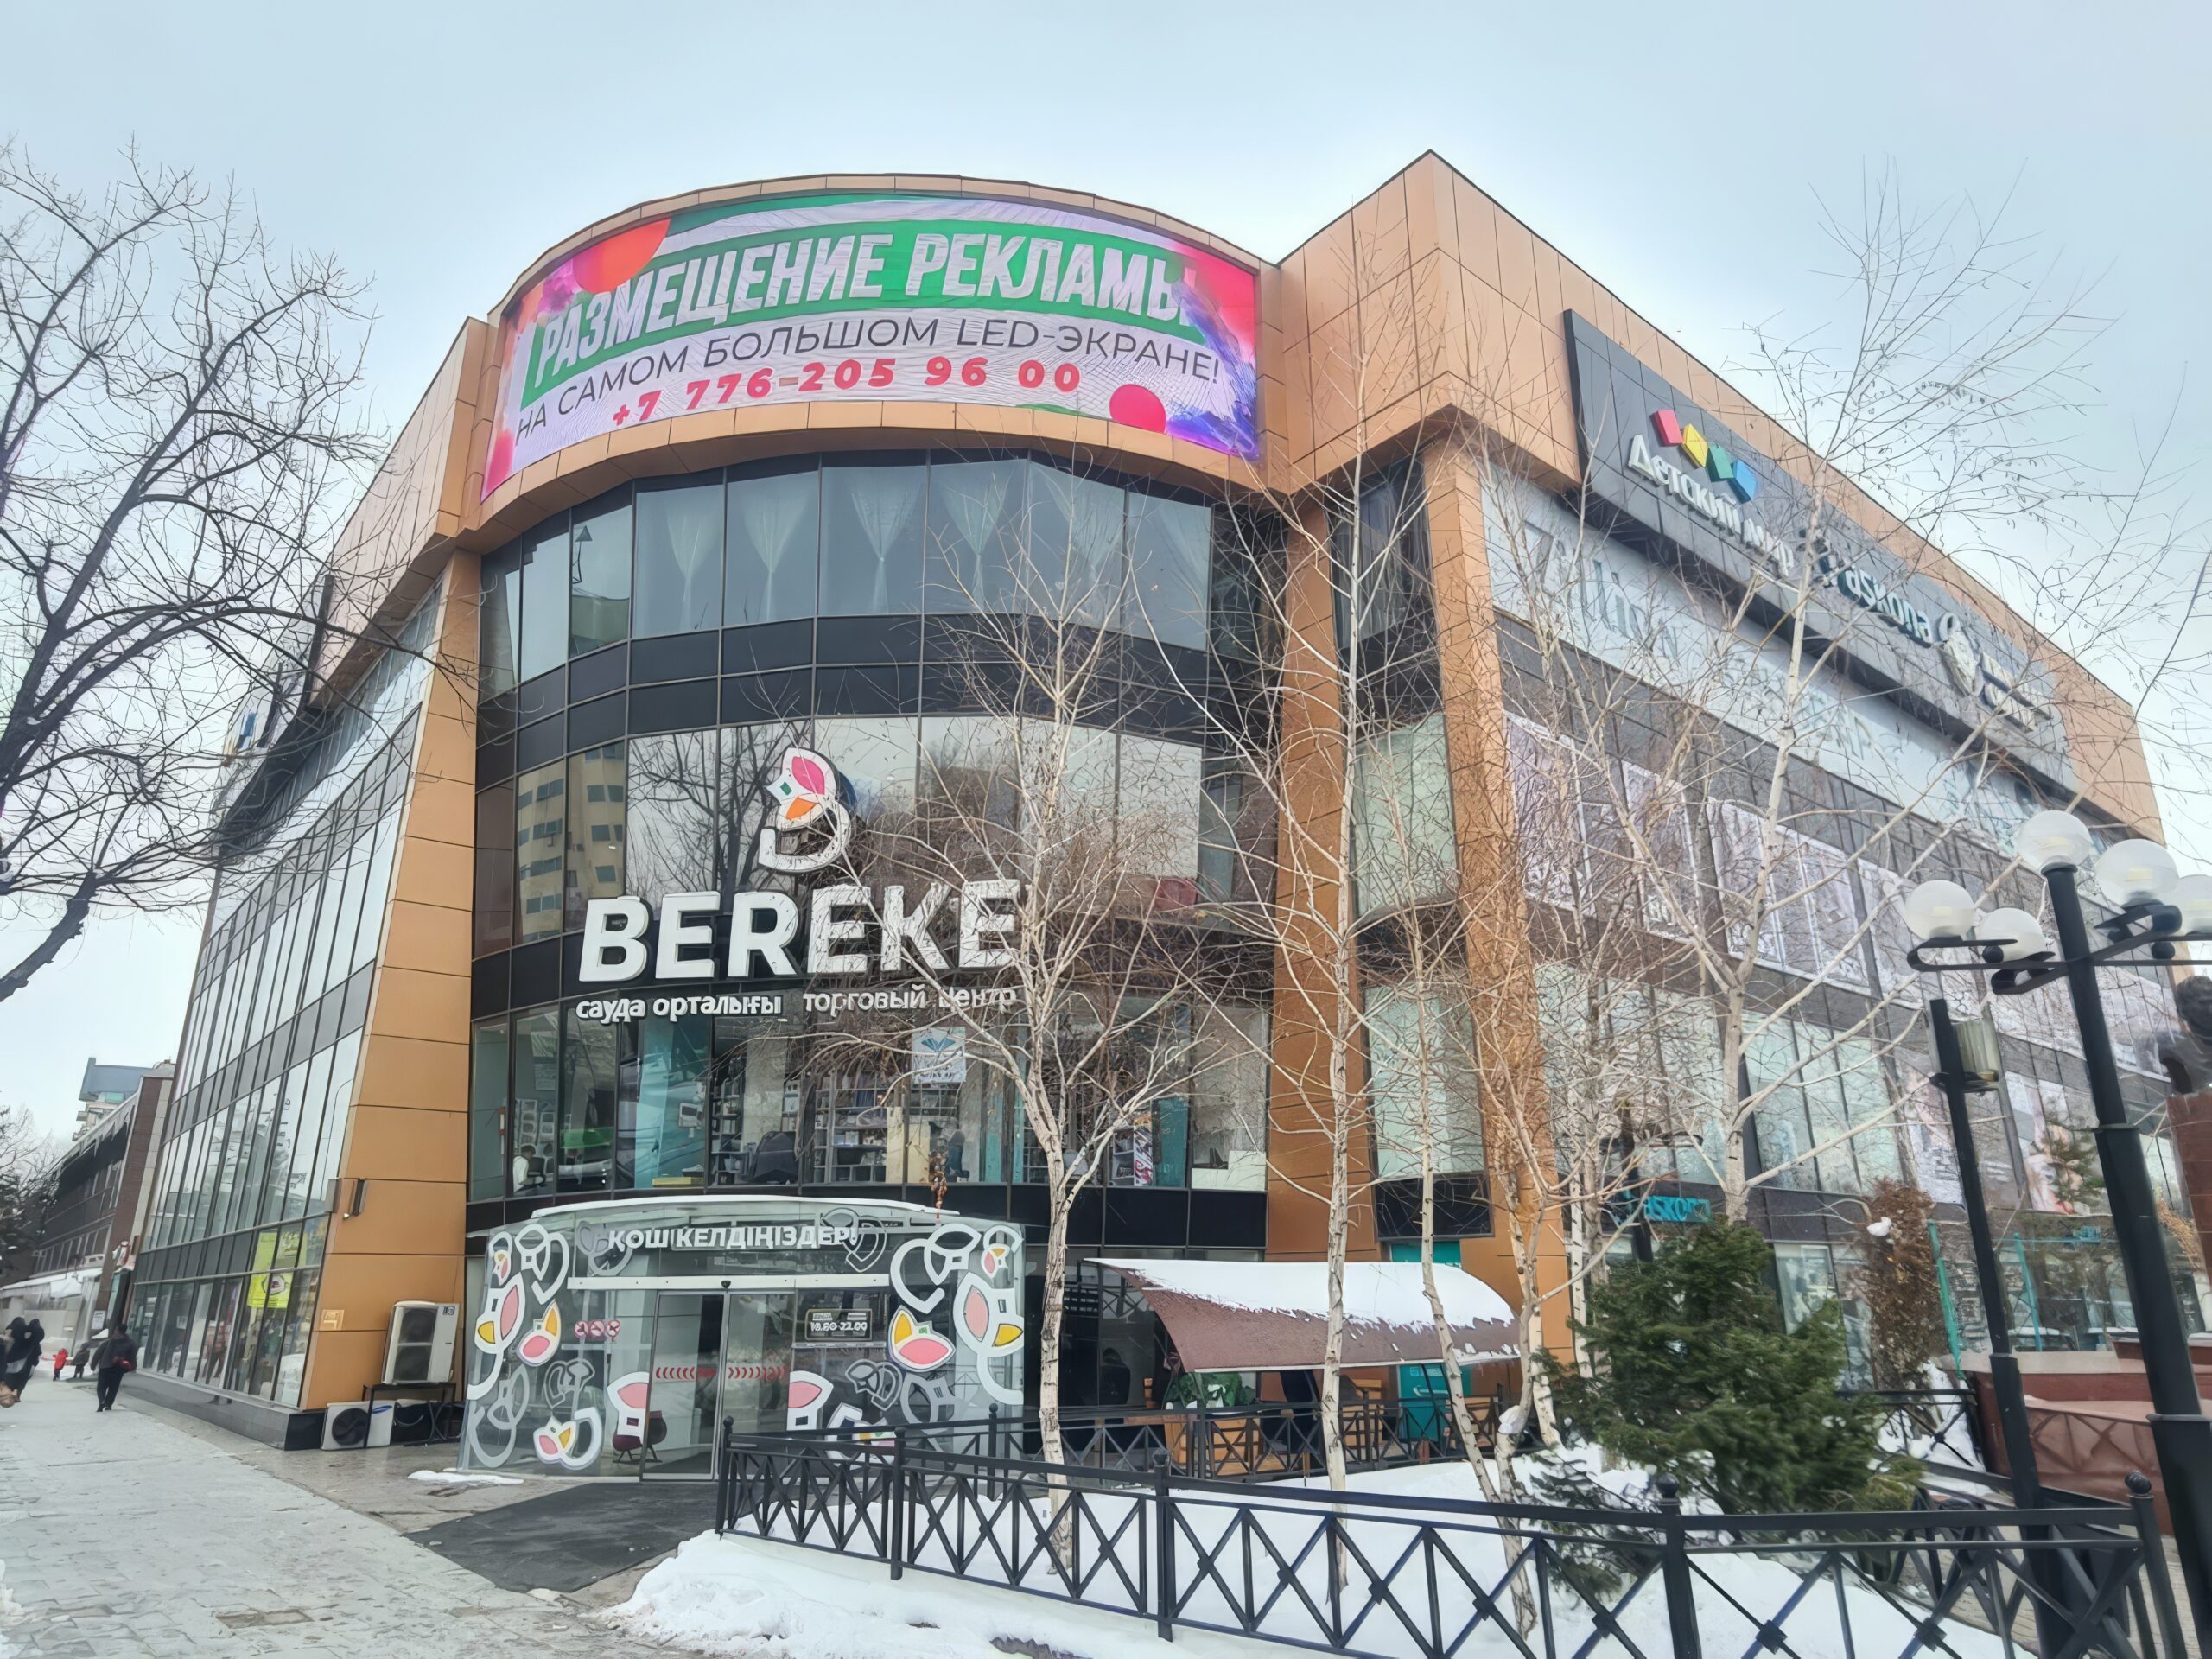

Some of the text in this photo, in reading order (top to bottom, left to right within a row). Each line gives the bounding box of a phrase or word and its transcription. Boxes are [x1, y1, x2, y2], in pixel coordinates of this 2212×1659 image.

[534, 232, 1198, 389] РАЗМЕЩЕНИЕ РЕКЛАМЫ
[516, 316, 1220, 446] НА САМОМ БОЛЬШОМ LED-ЭКРАНЕ!
[613, 391, 662, 426] +7
[925, 356, 989, 387] 96
[1018, 359, 1081, 392] 00
[1627, 434, 1742, 537] Детский
[578, 878, 1021, 982] BEREKE
[575, 995, 646, 1025] сауда
[652, 994, 782, 1022] орталығы
[803, 983, 927, 1016] торговый
[607, 1229, 669, 1252] ҚОШ
